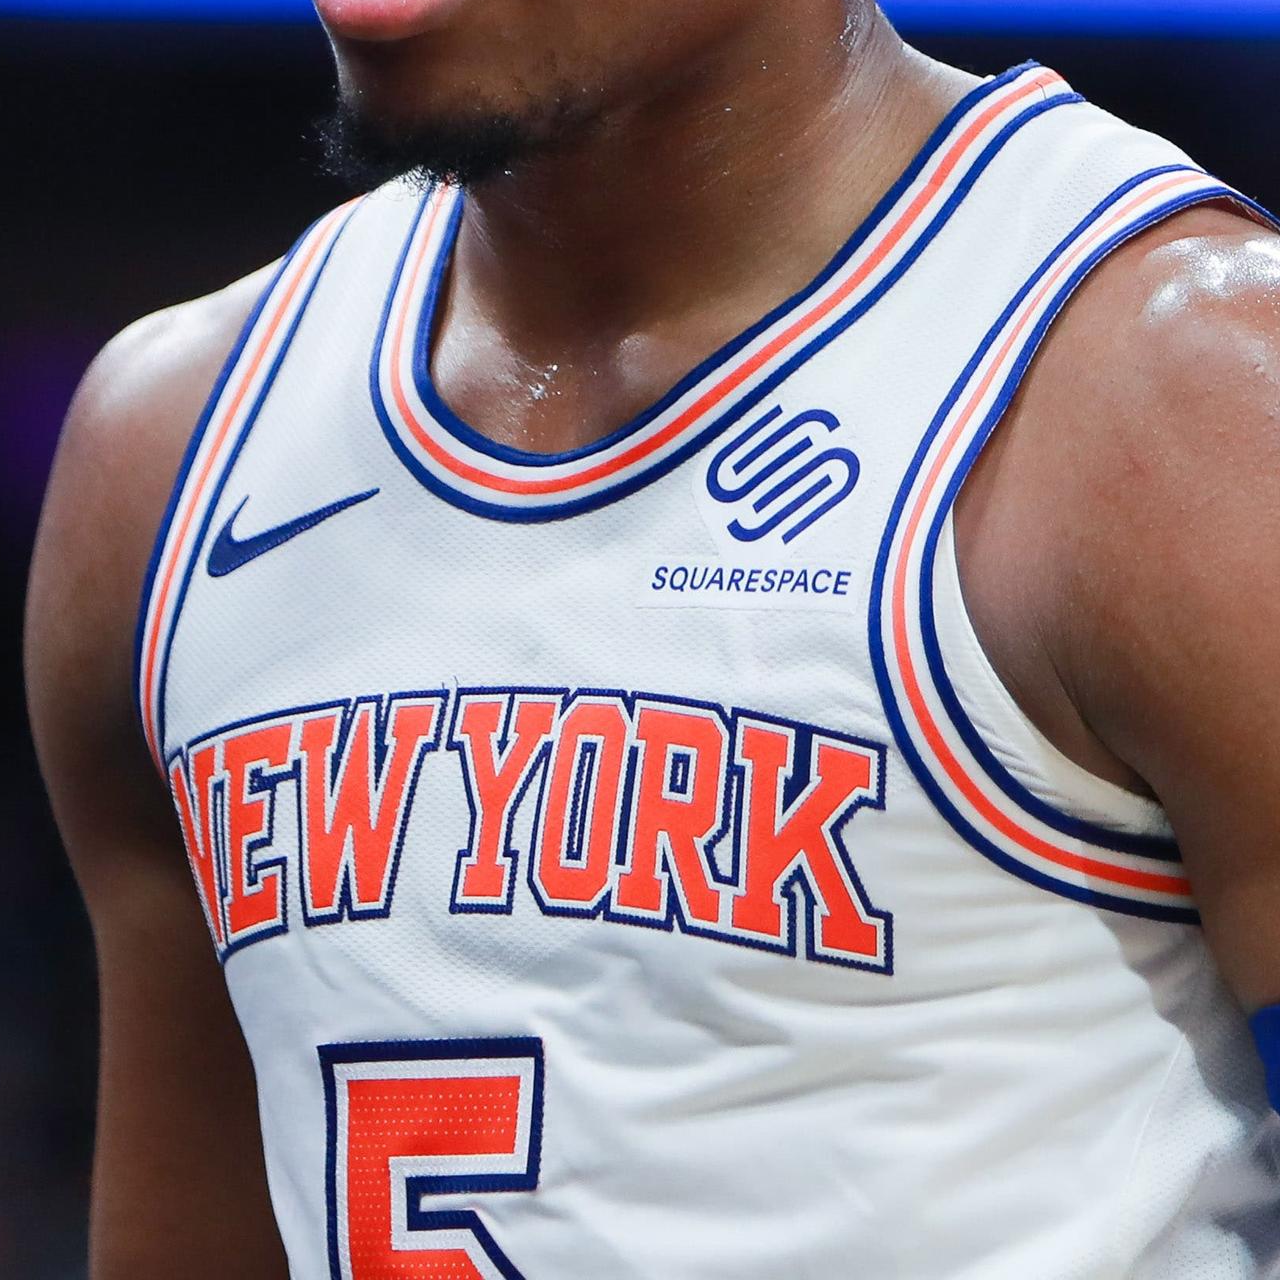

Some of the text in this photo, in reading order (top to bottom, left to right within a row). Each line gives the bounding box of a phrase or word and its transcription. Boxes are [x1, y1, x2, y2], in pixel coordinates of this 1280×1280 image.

[651, 566, 852, 596] SQUARESPACE
[169, 686, 895, 977] NEW YORK
[316, 1036, 545, 1280] 5
